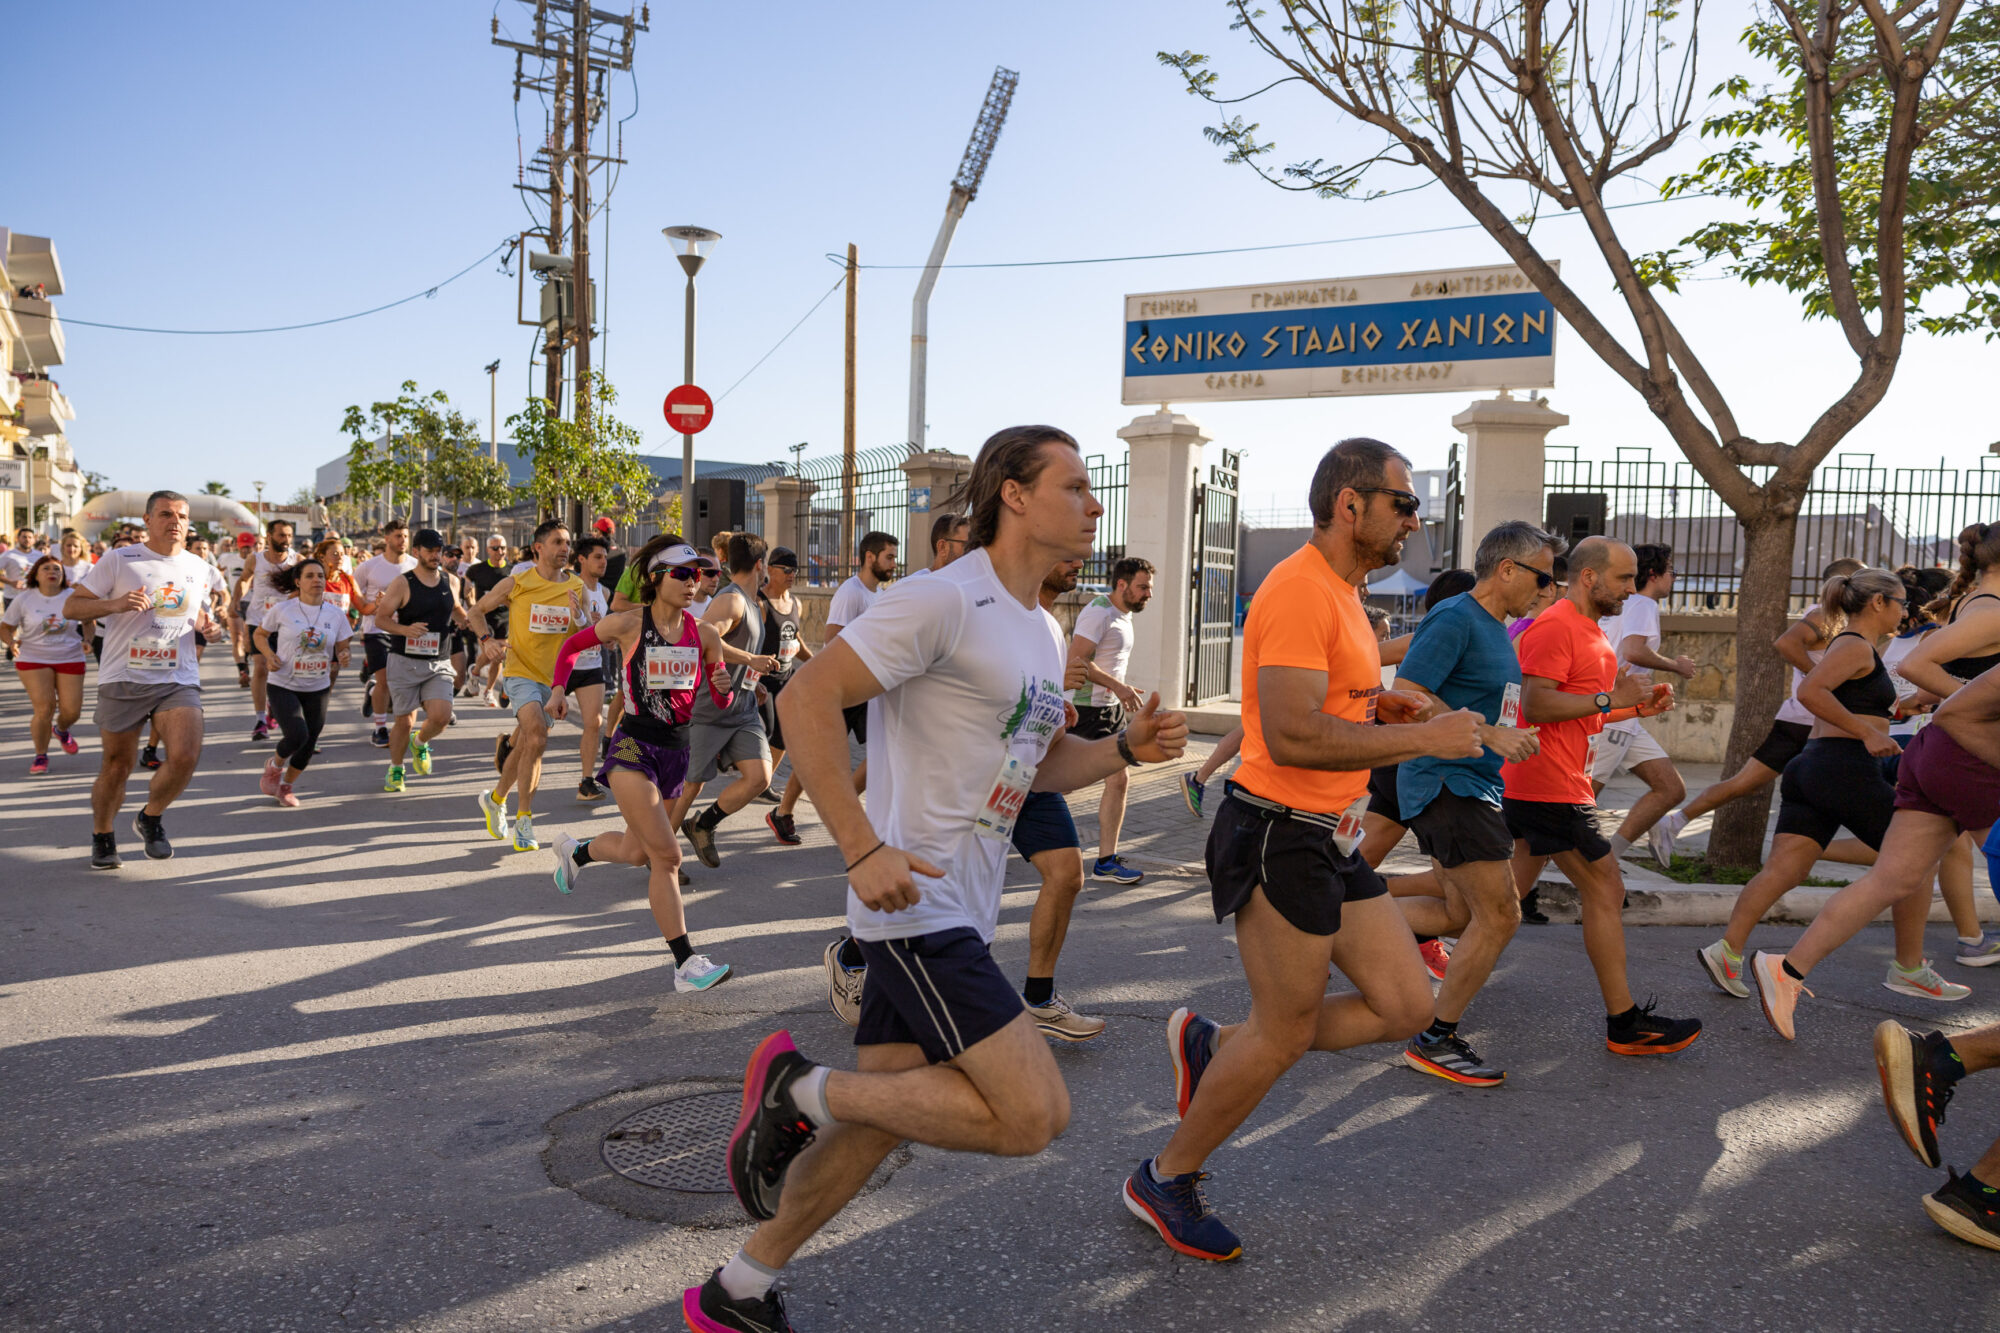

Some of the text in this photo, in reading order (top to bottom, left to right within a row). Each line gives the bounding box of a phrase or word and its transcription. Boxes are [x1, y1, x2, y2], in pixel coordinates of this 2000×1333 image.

[1141, 298, 1198, 316] ΓΕΝΙΚΗ
[1250, 286, 1358, 309] ΓΡΑΜΜΑΤΕΙΑ
[1130, 330, 1247, 364] ΕΘΝΙΚΟ
[1396, 309, 1547, 350] ΧΑΝΙΩΝ
[1204, 362, 1455, 390] ΕΛΕΝΑ ΒΕΝΙΖΕΛΟΥ
[536, 613, 565, 625] 1053
[136, 647, 171, 660] 1220
[656, 660, 692, 675] 1100
[1037, 691, 1064, 709] ΔΡΟΜΕ
